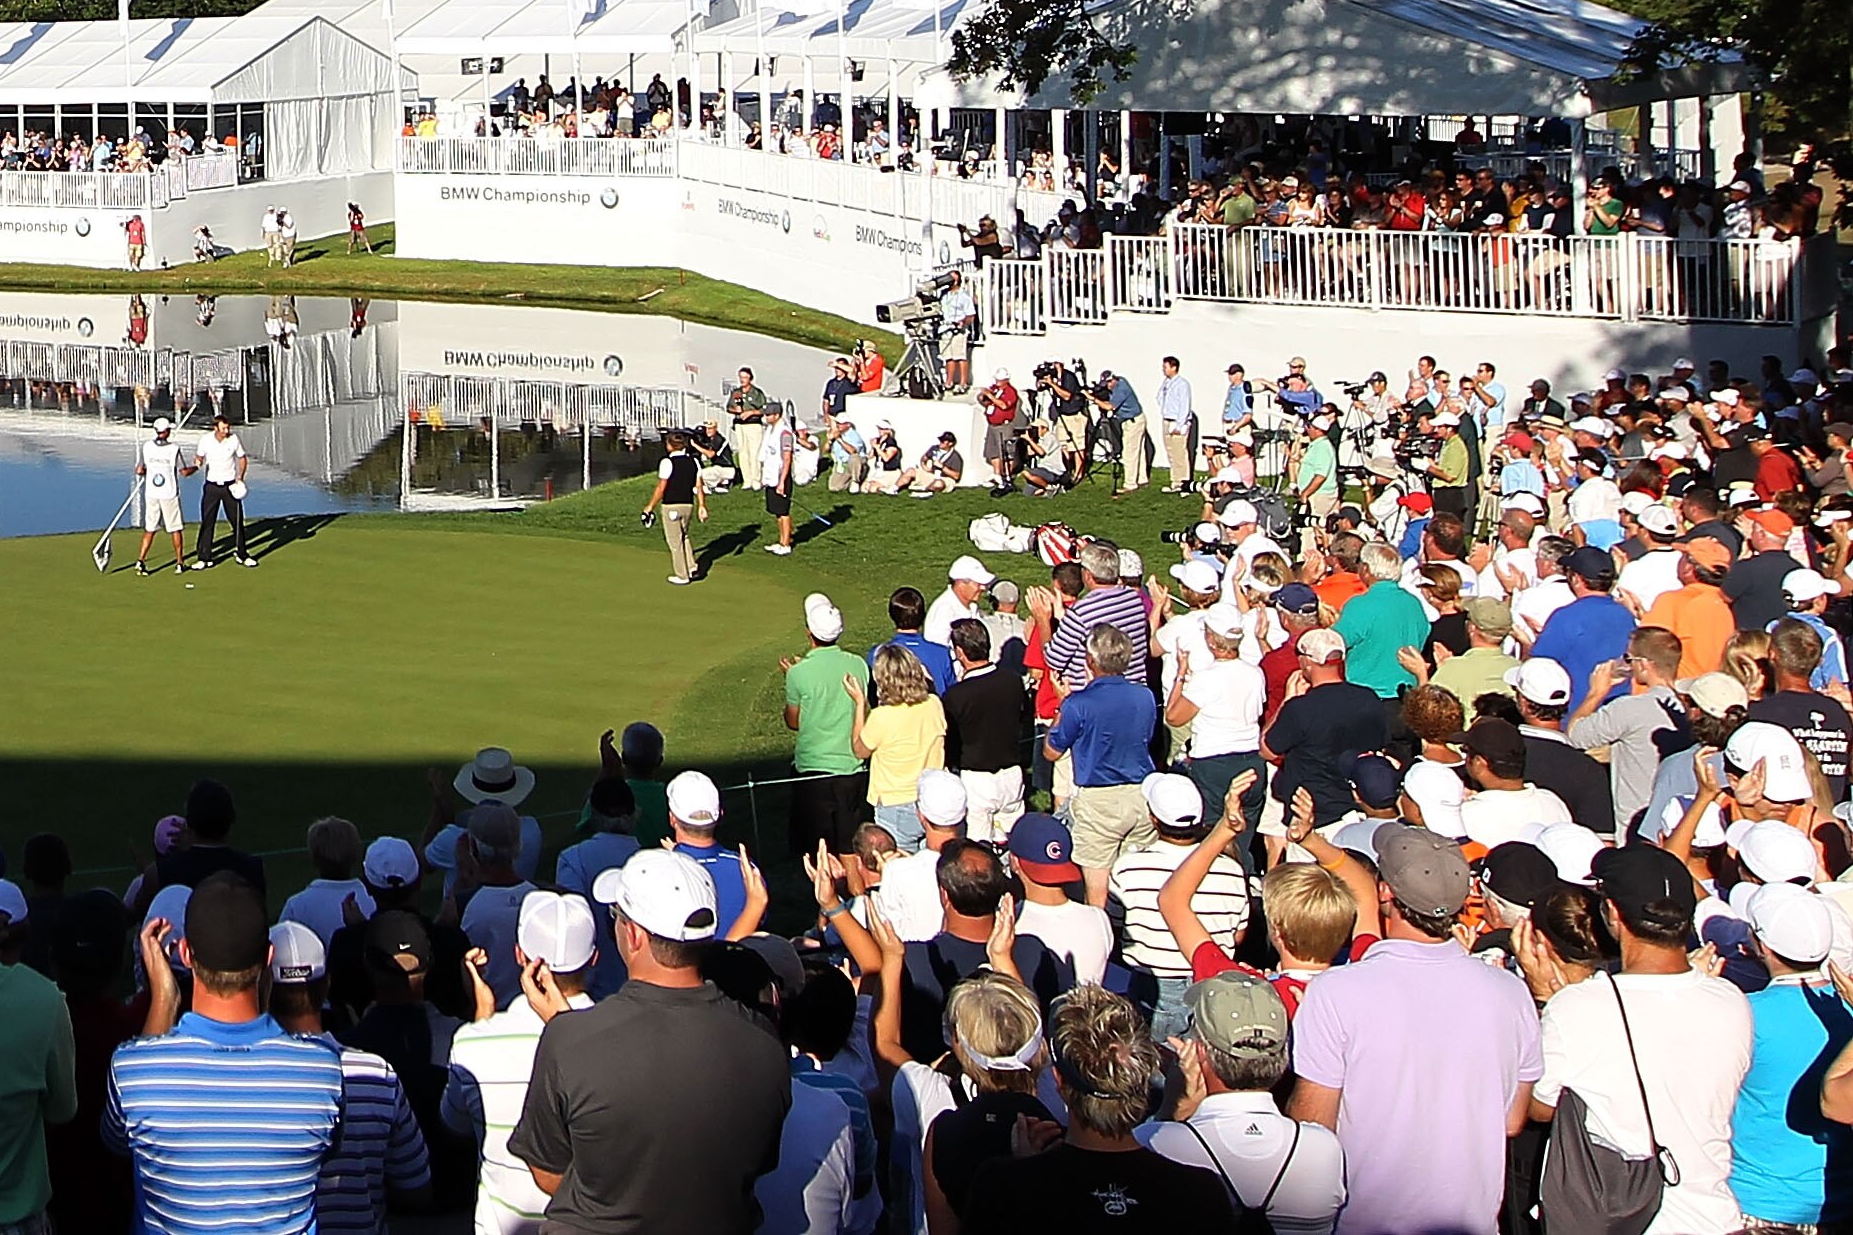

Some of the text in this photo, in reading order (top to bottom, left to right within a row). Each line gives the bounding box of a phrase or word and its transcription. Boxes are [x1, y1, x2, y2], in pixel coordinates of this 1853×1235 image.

[441, 187, 590, 205] BMW Championship
[856, 225, 876, 245] BMW
